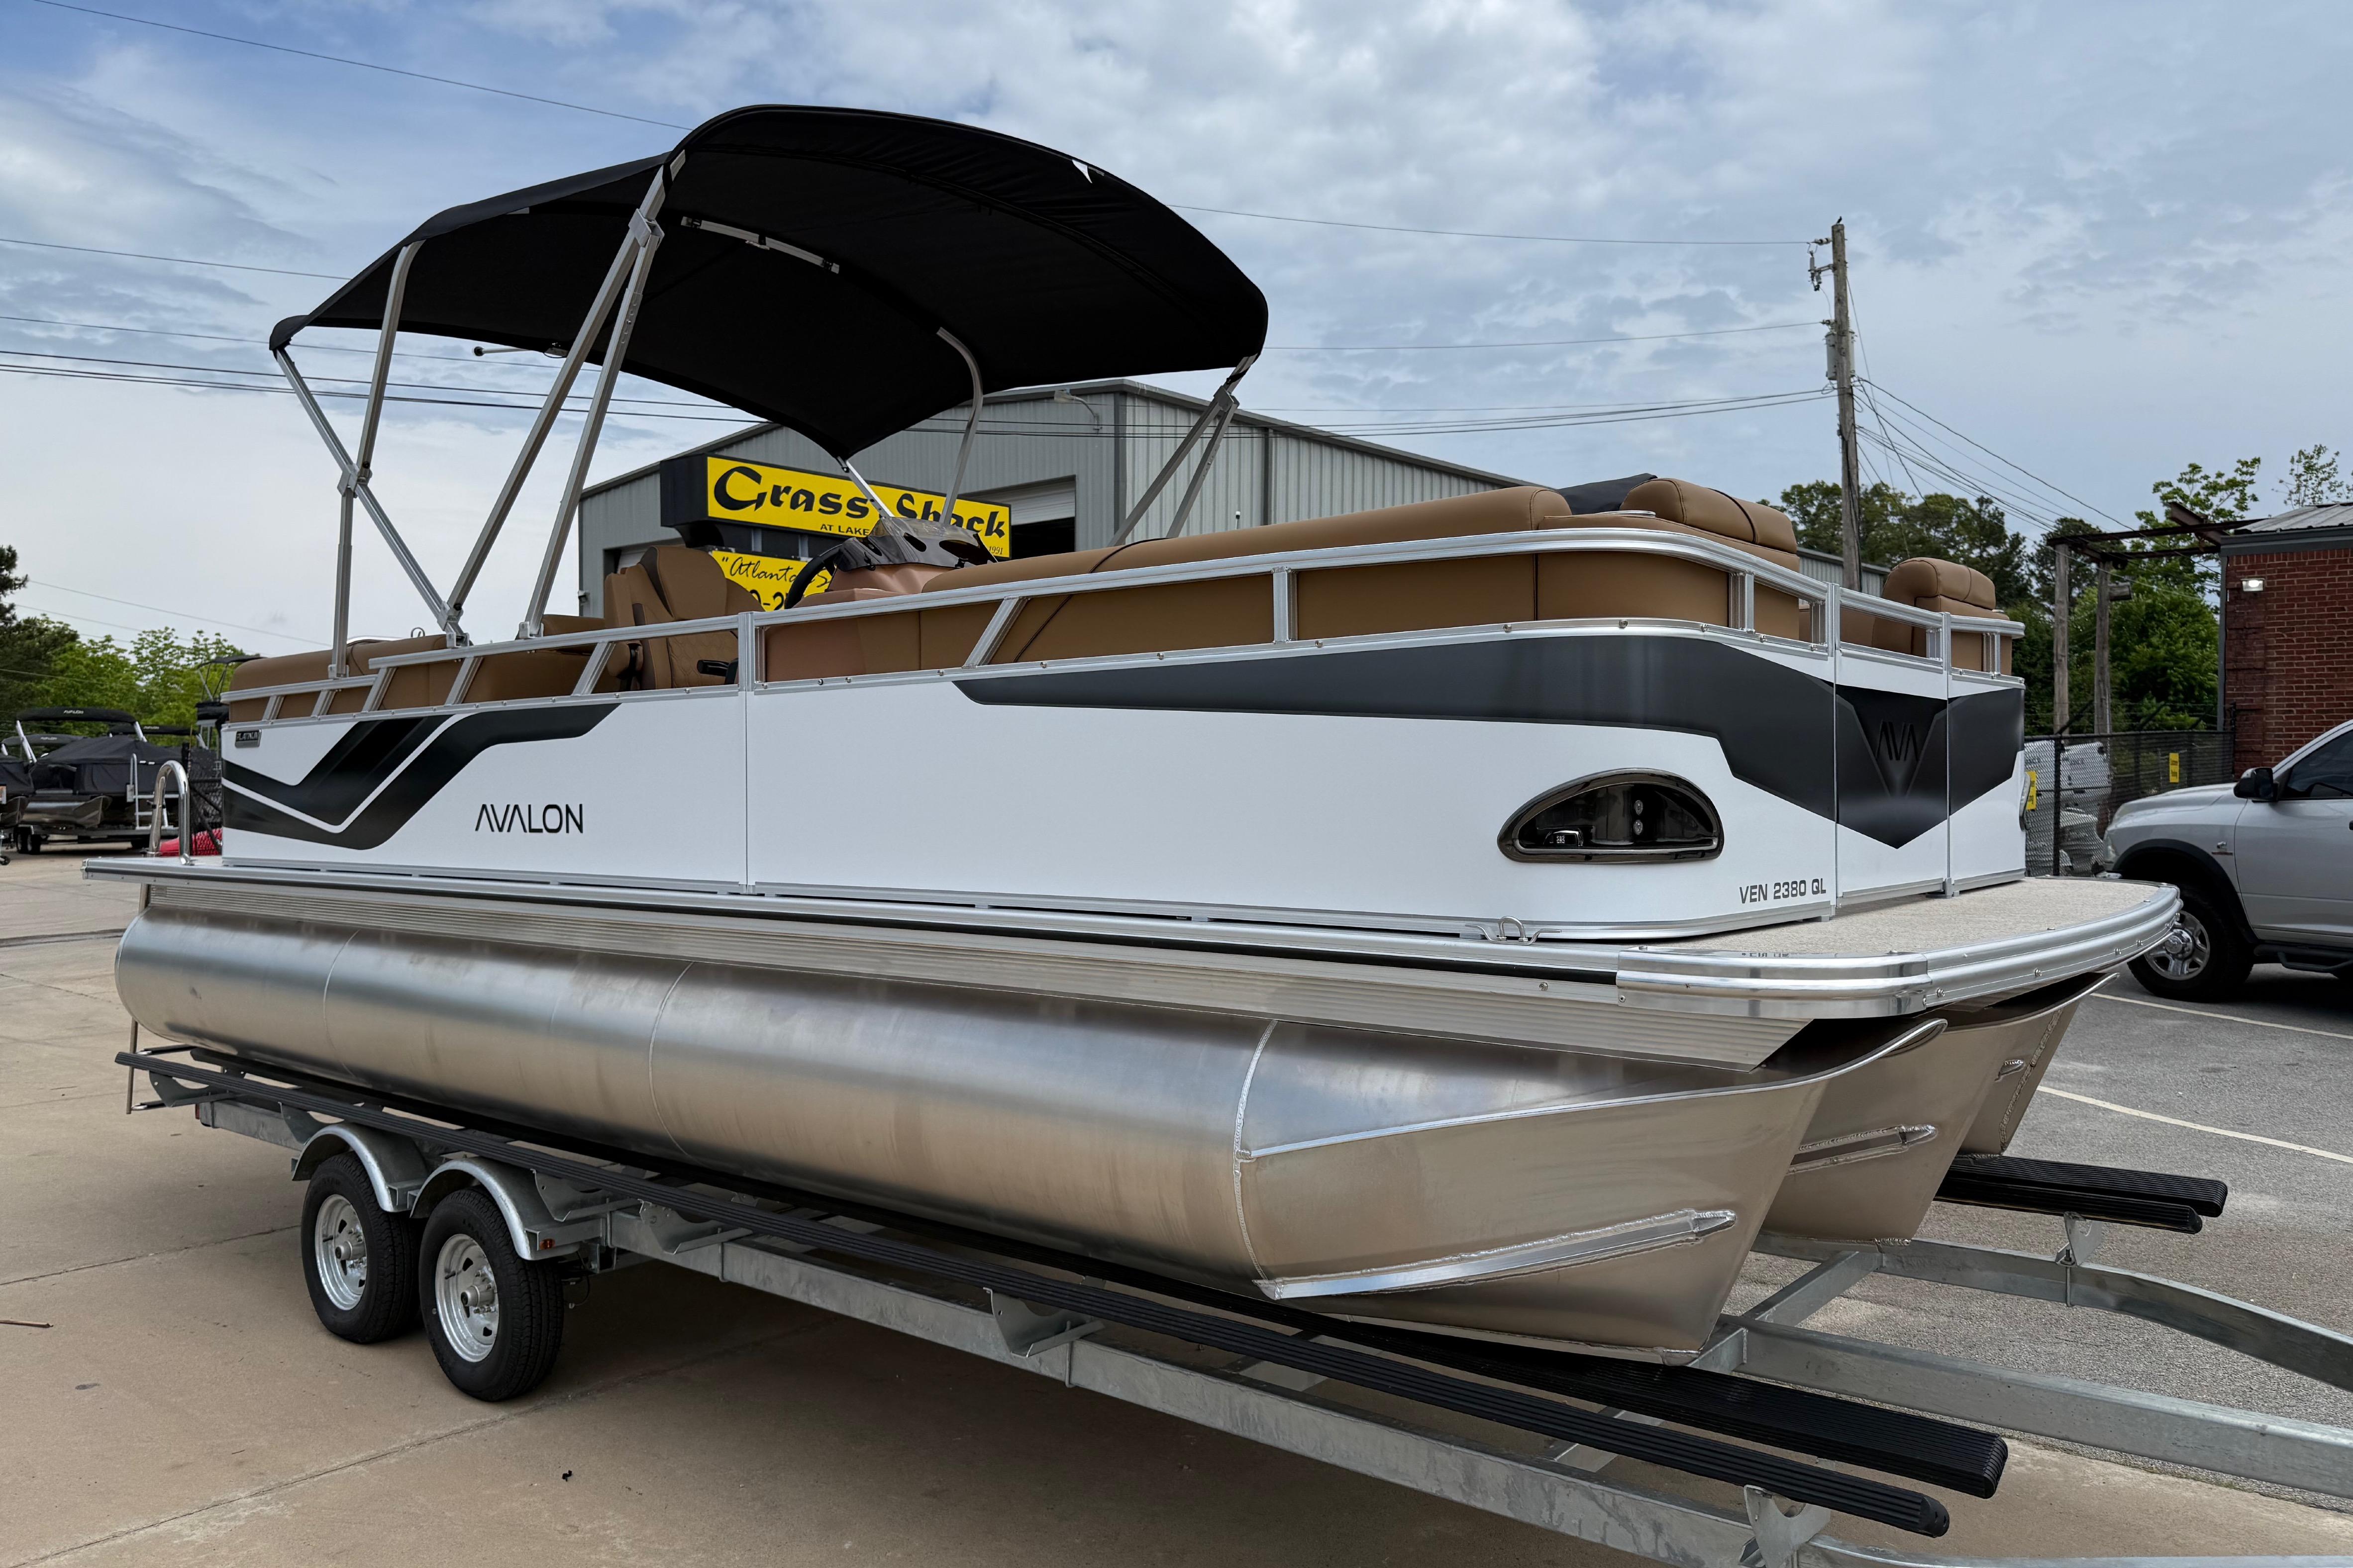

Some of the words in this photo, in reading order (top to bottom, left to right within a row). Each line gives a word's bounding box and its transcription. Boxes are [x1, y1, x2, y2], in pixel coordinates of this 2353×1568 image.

[714, 466, 870, 518] Grass
[838, 525, 870, 536] LAKE
[989, 546, 1003, 555] 1991
[475, 803, 583, 833] AVALON
[1739, 883, 1767, 904] VEN
[1773, 880, 1806, 900] 2380
[1812, 878, 1826, 895] QL
